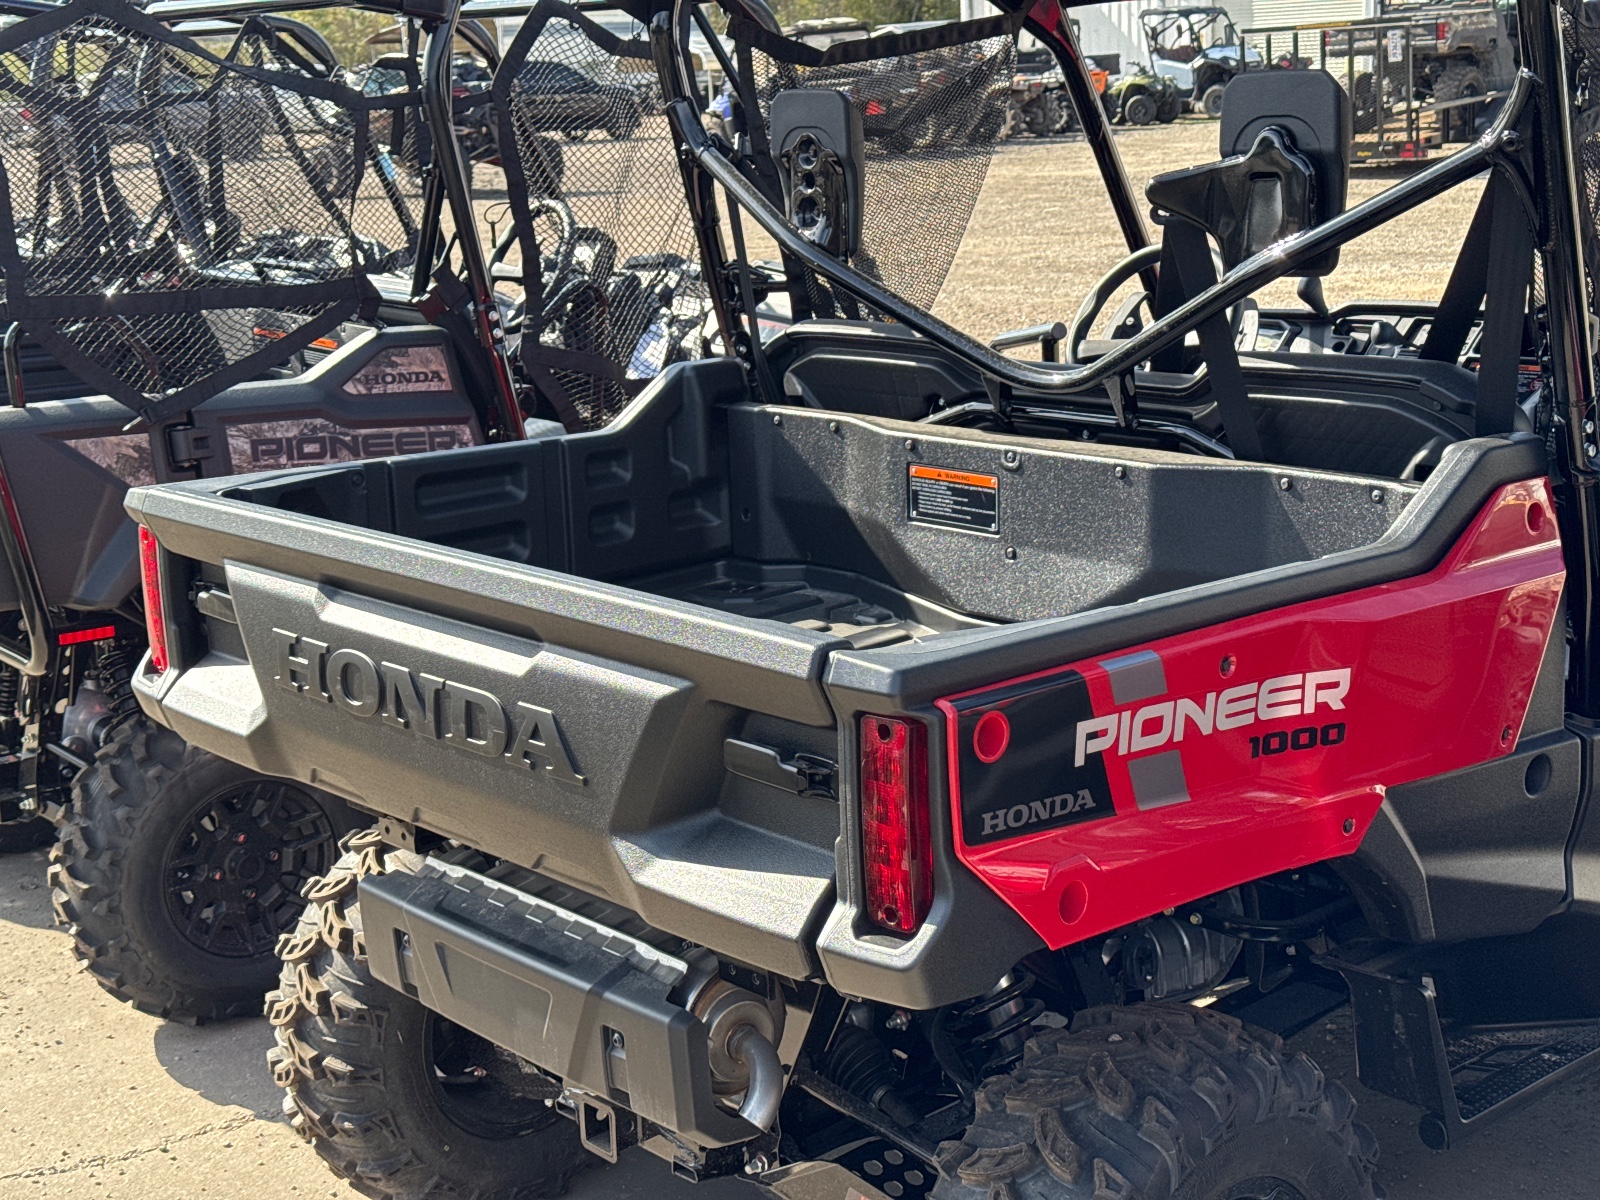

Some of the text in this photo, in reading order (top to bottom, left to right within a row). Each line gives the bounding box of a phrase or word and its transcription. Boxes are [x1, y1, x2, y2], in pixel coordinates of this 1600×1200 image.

[363, 371, 446, 386] HONDA
[250, 431, 458, 462] PIONEER
[944, 472, 970, 482] WARNING
[272, 627, 588, 787] HONDA
[1074, 667, 1352, 767] PIONEER
[1249, 722, 1346, 759] 1000
[981, 788, 1096, 836] HONDA
